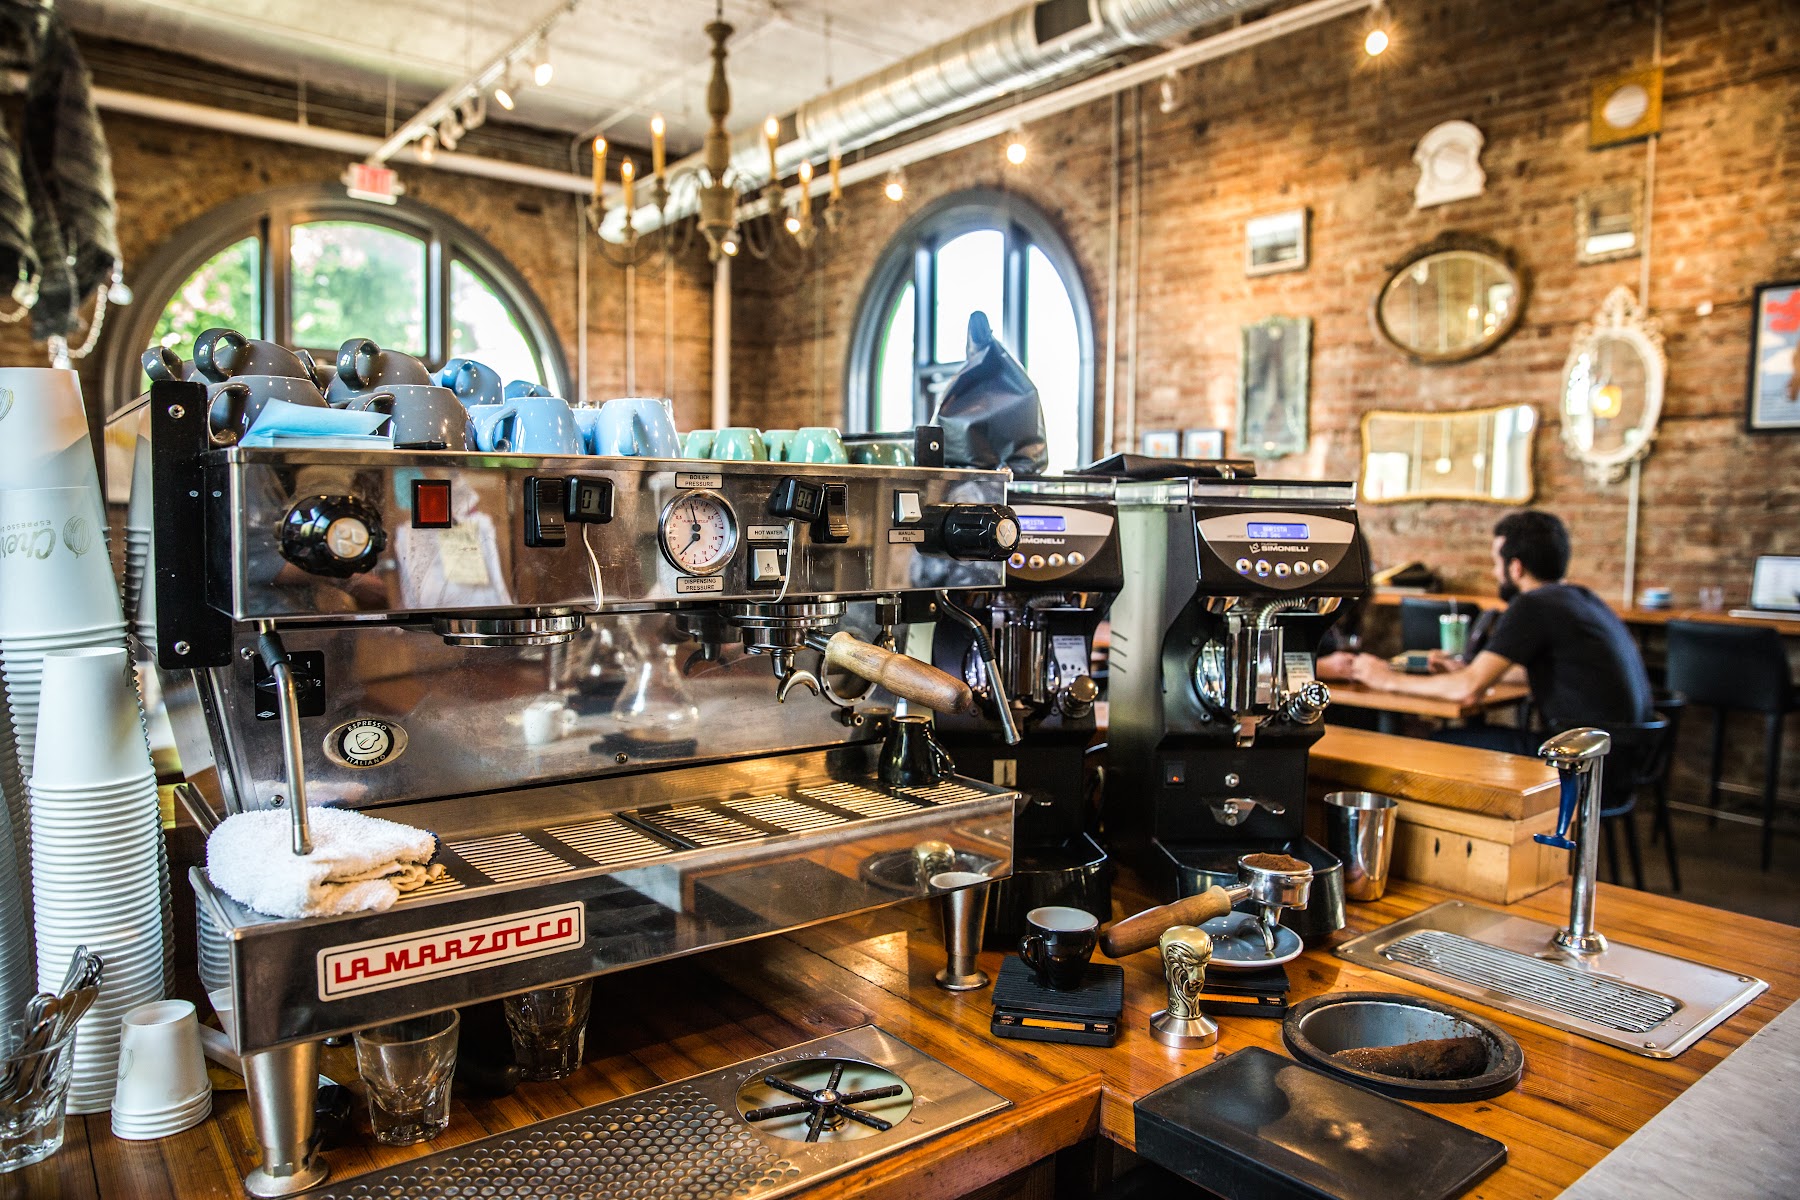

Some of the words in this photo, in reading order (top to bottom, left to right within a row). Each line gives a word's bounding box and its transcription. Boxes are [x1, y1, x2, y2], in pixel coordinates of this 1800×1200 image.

[6, 519, 51, 531] ESPRESSO
[1262, 525, 1288, 533] BARISTA
[0, 528, 56, 560] Cher
[1020, 537, 1066, 545] IMONELLI
[1261, 545, 1309, 553] SIMONELLI
[347, 720, 388, 732] ESPRESSO
[346, 754, 386, 766] ITALIANO
[334, 956, 370, 984] LA
[385, 917, 573, 974] MARZOCCO
